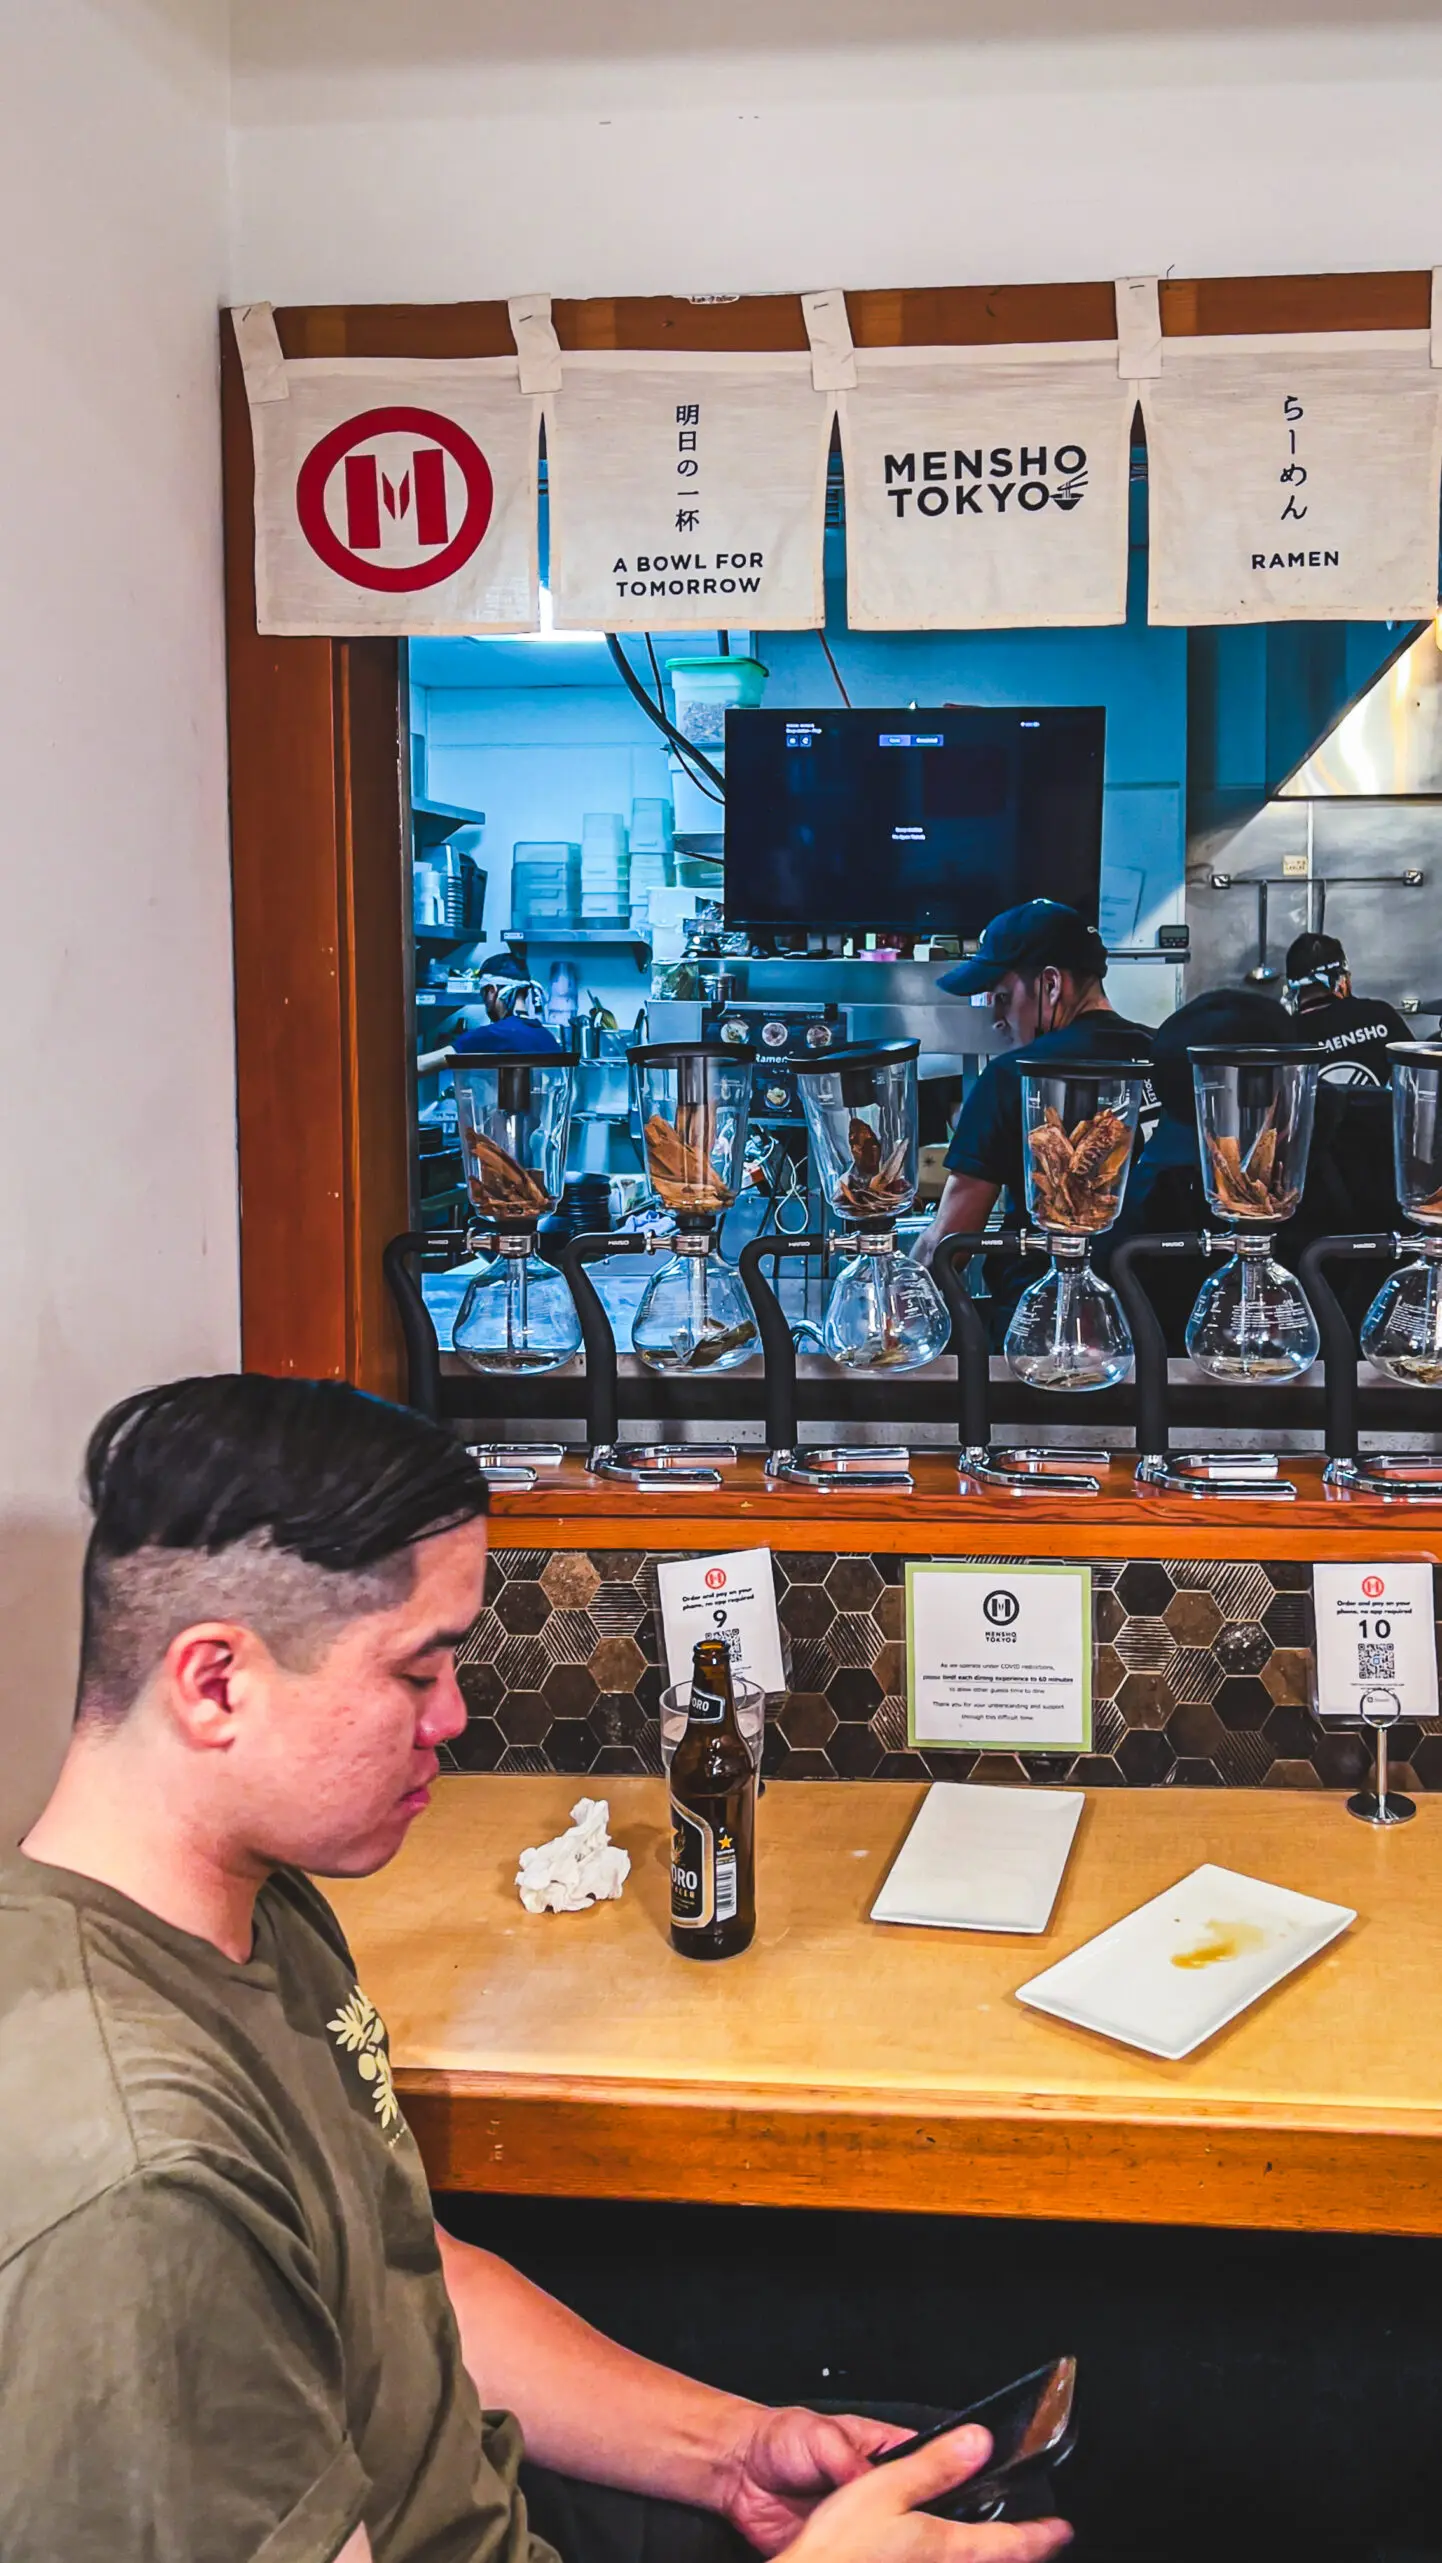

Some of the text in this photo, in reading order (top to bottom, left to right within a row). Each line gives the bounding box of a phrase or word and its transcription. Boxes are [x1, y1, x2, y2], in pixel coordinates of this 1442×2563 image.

[675, 404, 700, 532] 明日の一杯
[884, 444, 1088, 485] MENSHO
[1279, 395, 1308, 521] らーめん
[887, 480, 1050, 518] TOKYO
[613, 552, 764, 573] A BOWL FOR
[1251, 550, 1339, 569] RAMEN
[616, 577, 761, 597] TOMORROW
[1318, 1024, 1388, 1053] MENSHO
[713, 1610, 727, 1628] 9
[1359, 1619, 1391, 1639] 10
